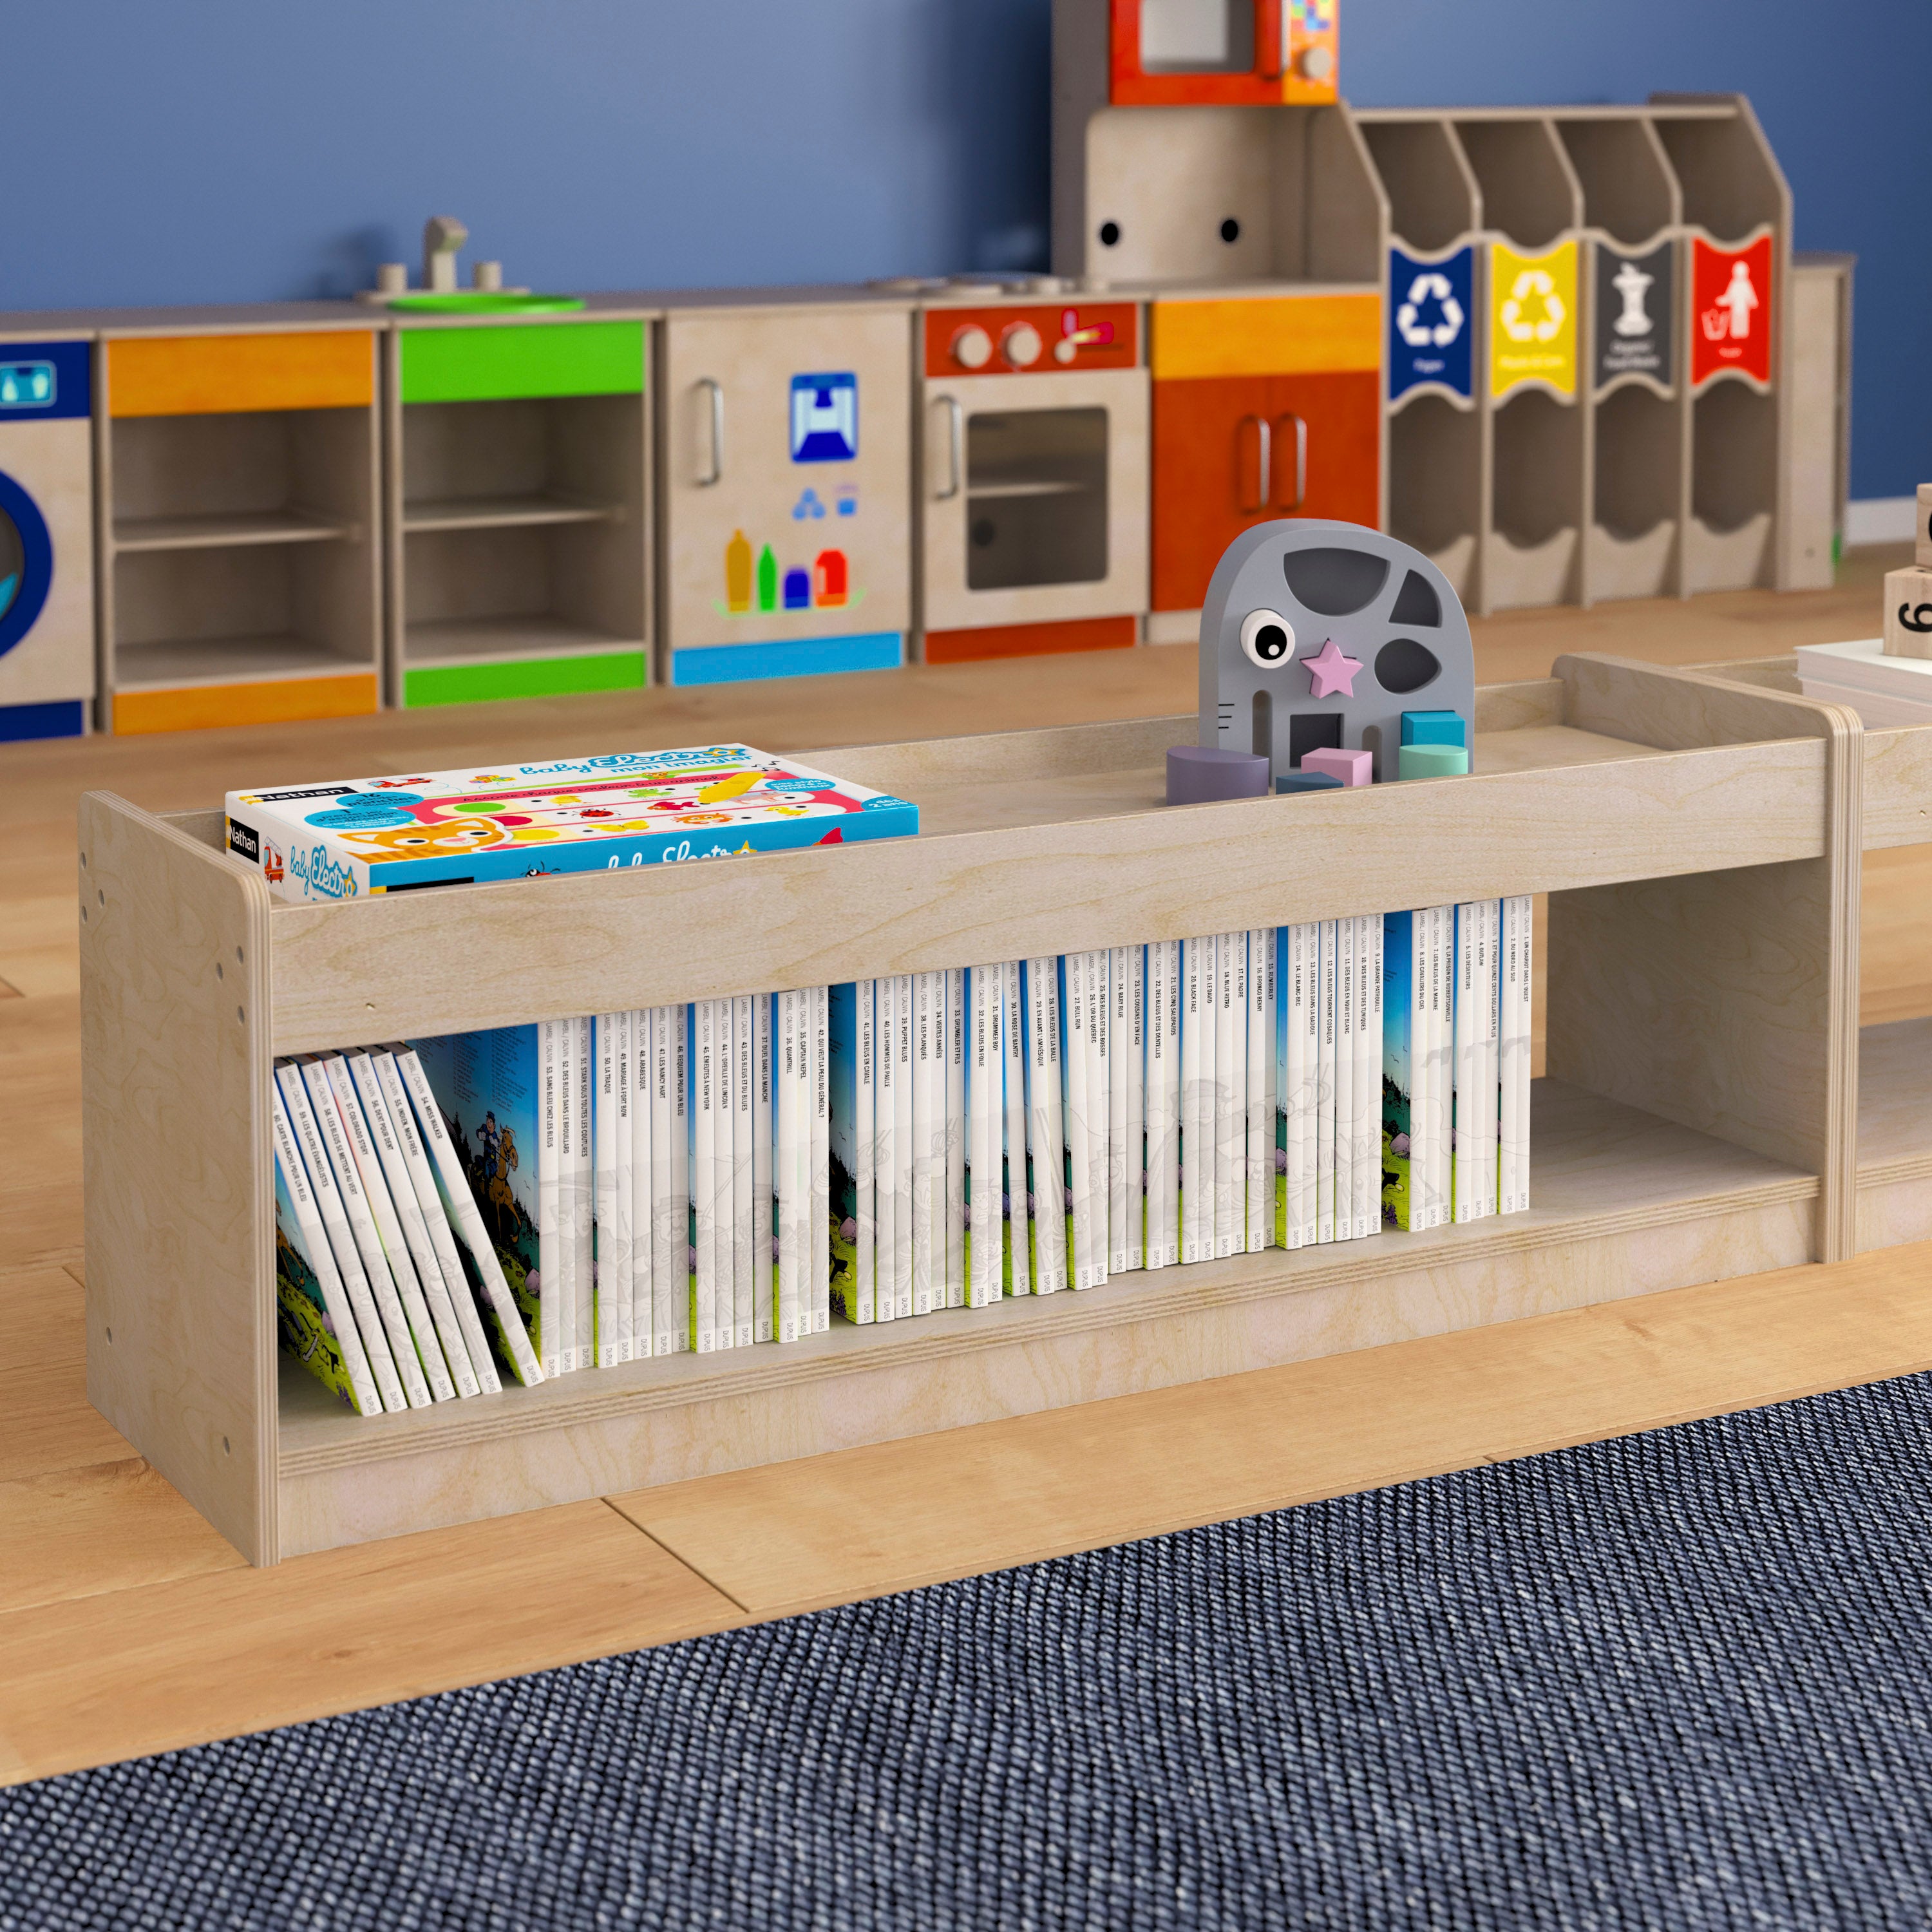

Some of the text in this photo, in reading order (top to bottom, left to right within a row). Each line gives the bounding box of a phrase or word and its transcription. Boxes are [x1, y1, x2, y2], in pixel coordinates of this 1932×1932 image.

[519, 748, 738, 774] baby Electro
[611, 755, 752, 773] mon imagier
[256, 788, 344, 801] Nathan
[463, 794, 516, 802] Associe
[522, 789, 573, 798] chaque
[578, 784, 634, 792] couleur
[229, 824, 256, 854] Nathan
[290, 846, 355, 897] baby Electro
[375, 1110, 384, 1122] DENT
[424, 1106, 433, 1119] MISS
[431, 1120, 442, 1139] WALKER
[349, 1112, 362, 1139] COLORADO
[358, 1139, 368, 1155] STORY
[379, 1123, 388, 1137] POUR
[384, 1138, 393, 1150] DENT
[305, 1131, 316, 1151] QUATRE
[312, 1151, 328, 1187] ÉVANGÉLISTES
[437, 1380, 449, 1397] DUPUIS
[485, 1375, 496, 1392] DUPUIS
[365, 1396, 376, 1413] DUPUIS
